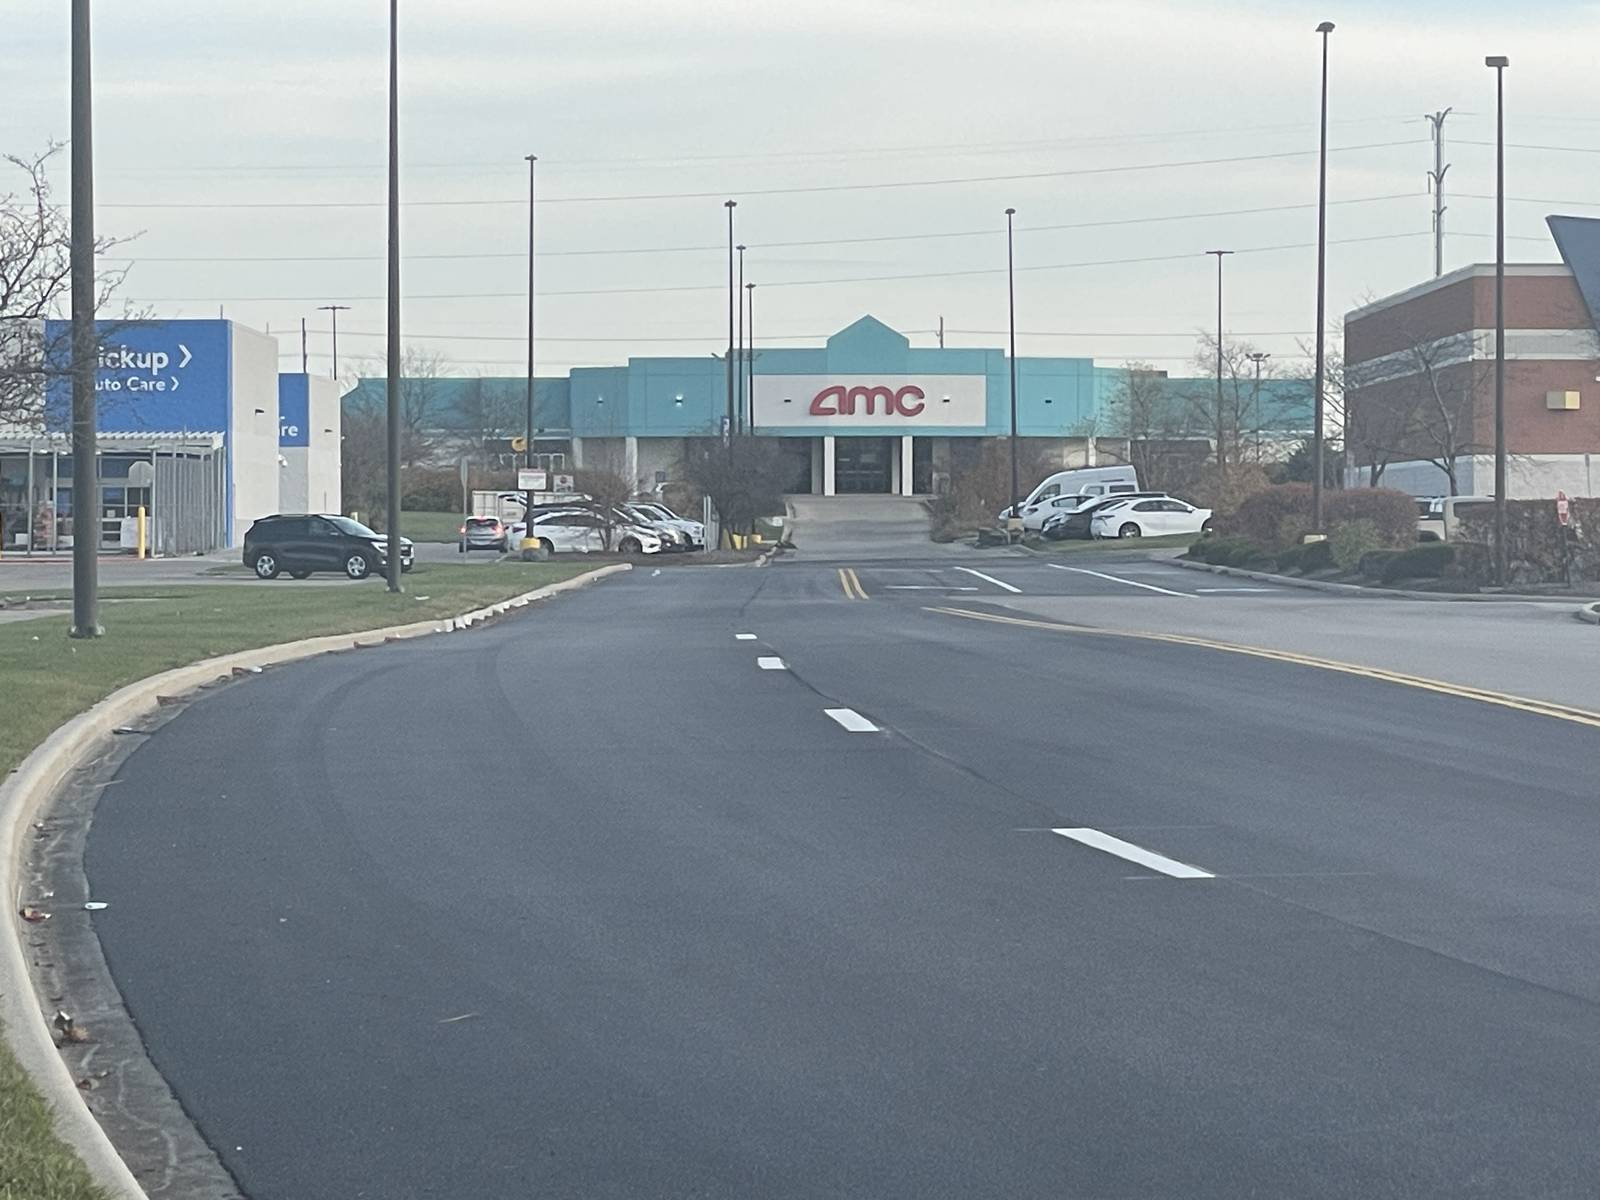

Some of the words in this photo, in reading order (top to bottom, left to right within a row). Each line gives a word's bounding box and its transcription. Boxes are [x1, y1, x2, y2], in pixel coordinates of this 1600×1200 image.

[97, 344, 169, 376] ickup
[94, 378, 121, 391] uto
[126, 376, 166, 391] Care
[281, 425, 298, 437] re
